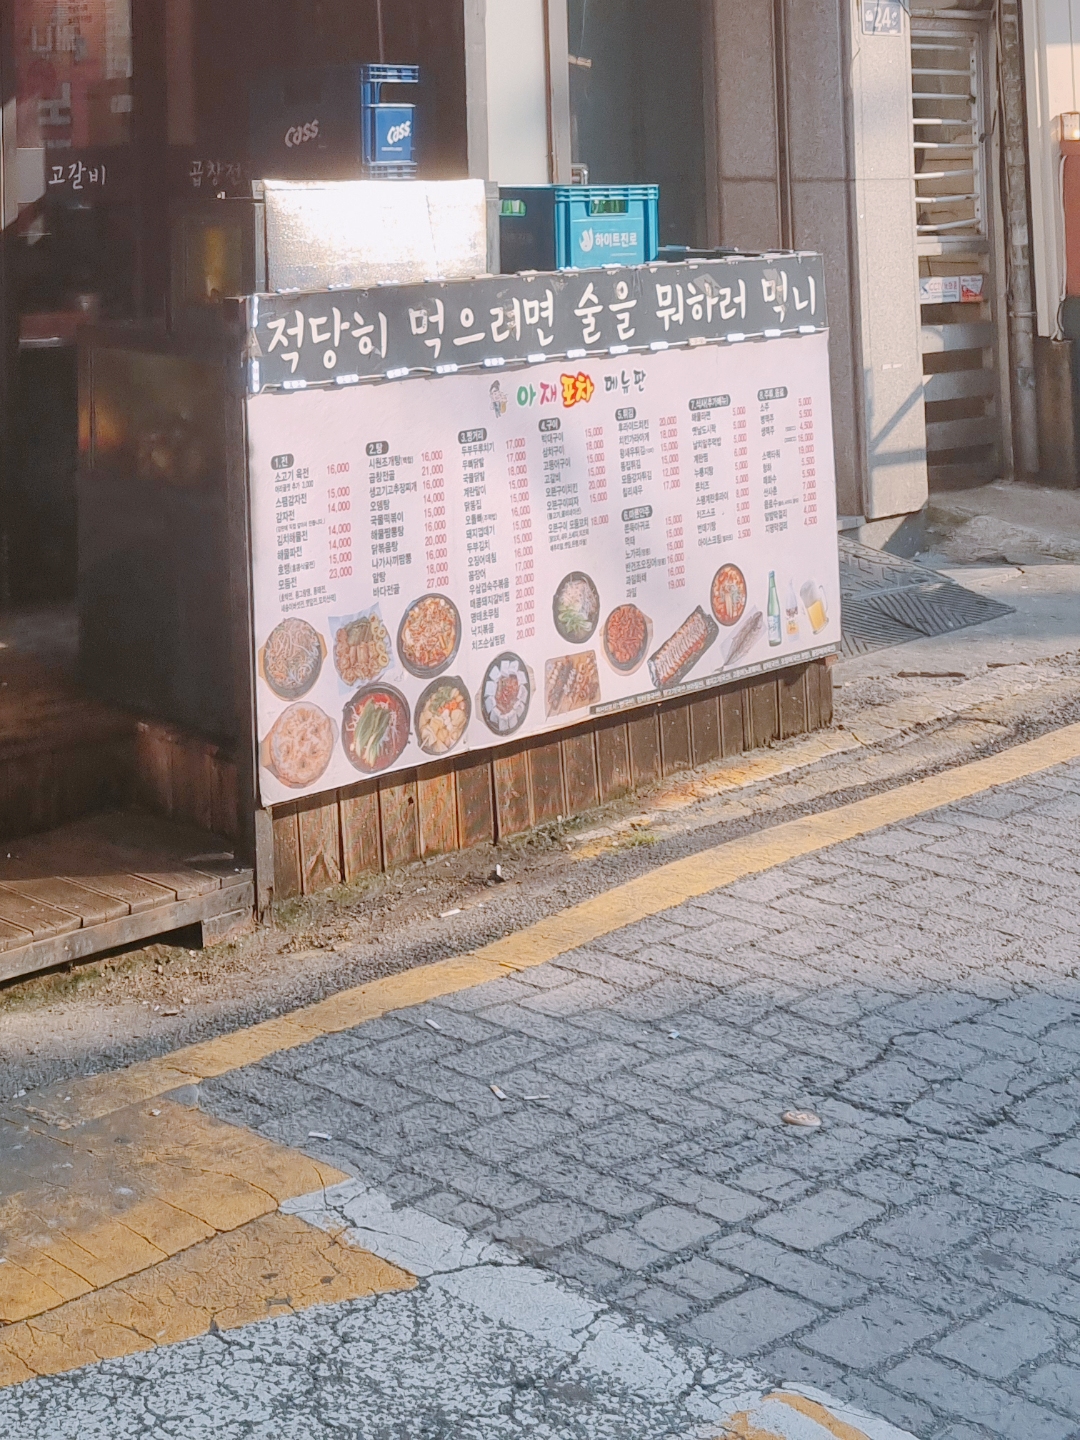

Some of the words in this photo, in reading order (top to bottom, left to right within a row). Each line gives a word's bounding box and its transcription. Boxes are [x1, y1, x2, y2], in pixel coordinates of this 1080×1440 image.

[48, 161, 107, 191] 고갈비
[595, 232, 638, 248] 하이트진로
[266, 308, 389, 375] 적당히
[409, 287, 555, 362] 먹으려면
[573, 279, 639, 342] 술을
[655, 276, 748, 331] 뭐하러
[760, 270, 816, 324] 먹니
[515, 370, 596, 409] 아재포차
[604, 368, 648, 396] 메뉴판
[798, 396, 812, 407] 5,000
[732, 406, 746, 416] 5,000
[799, 408, 813, 418] 5,500
[618, 419, 649, 432] 후라이드치킨
[659, 415, 677, 427] 20,000
[733, 420, 747, 429] 5,000
[799, 420, 813, 430] 4,500
[584, 426, 603, 438] 15,000
[733, 433, 747, 443] 5,000
[505, 437, 526, 449] 17,000
[421, 449, 443, 462] 16,000
[506, 451, 527, 462] 17,000
[543, 456, 571, 471] 고등어구이
[586, 452, 605, 464] 15,000
[661, 453, 679, 464] 15,000
[326, 462, 350, 475] 16,000
[587, 466, 606, 477] 15,000
[662, 466, 680, 477] 12,000
[735, 460, 748, 471] 5,000
[369, 469, 396, 484] 곱창전골
[421, 463, 444, 476] 21,000
[735, 473, 749, 484] 5,000
[369, 481, 418, 499] 생고기고추장찌개
[422, 477, 444, 490] 16,000
[508, 478, 528, 490] 15,000
[545, 482, 579, 497] 오븐구이치킨
[588, 478, 607, 490] 20,000
[663, 479, 681, 491] 17,000
[327, 486, 351, 499] 15,000
[509, 491, 530, 503] 15,000
[370, 498, 390, 512] 오뎅탕
[423, 491, 445, 504] 14,000
[546, 496, 579, 511] 오븐구이피자
[589, 491, 608, 503] 15,000
[736, 501, 750, 512] 5,000
[276, 509, 295, 524] 감자전
[328, 500, 351, 513] 14,000
[424, 505, 446, 519] 15,000
[511, 505, 531, 517] 16,000
[424, 519, 447, 533] 16,000
[512, 518, 532, 531] 15,000
[665, 513, 683, 526] 15,000
[277, 529, 308, 547] 김치해물전
[328, 522, 351, 536] 14,000
[513, 532, 533, 545] 15,000
[666, 527, 684, 539] 15,000
[277, 545, 302, 561] 해물파전
[329, 537, 352, 550] 14,000
[371, 540, 399, 556] 닭볶음탕
[424, 533, 447, 547] 20,000
[329, 551, 352, 565] 15,000
[425, 547, 448, 561] 16,000
[514, 545, 533, 558] 16,000
[426, 561, 449, 575] 18,000
[515, 559, 534, 572] 17,000
[329, 566, 353, 580] 23,000
[515, 572, 534, 586] 20,000
[372, 583, 400, 598] 바다전골
[426, 575, 450, 589] 27,000
[515, 586, 535, 599] 20,000
